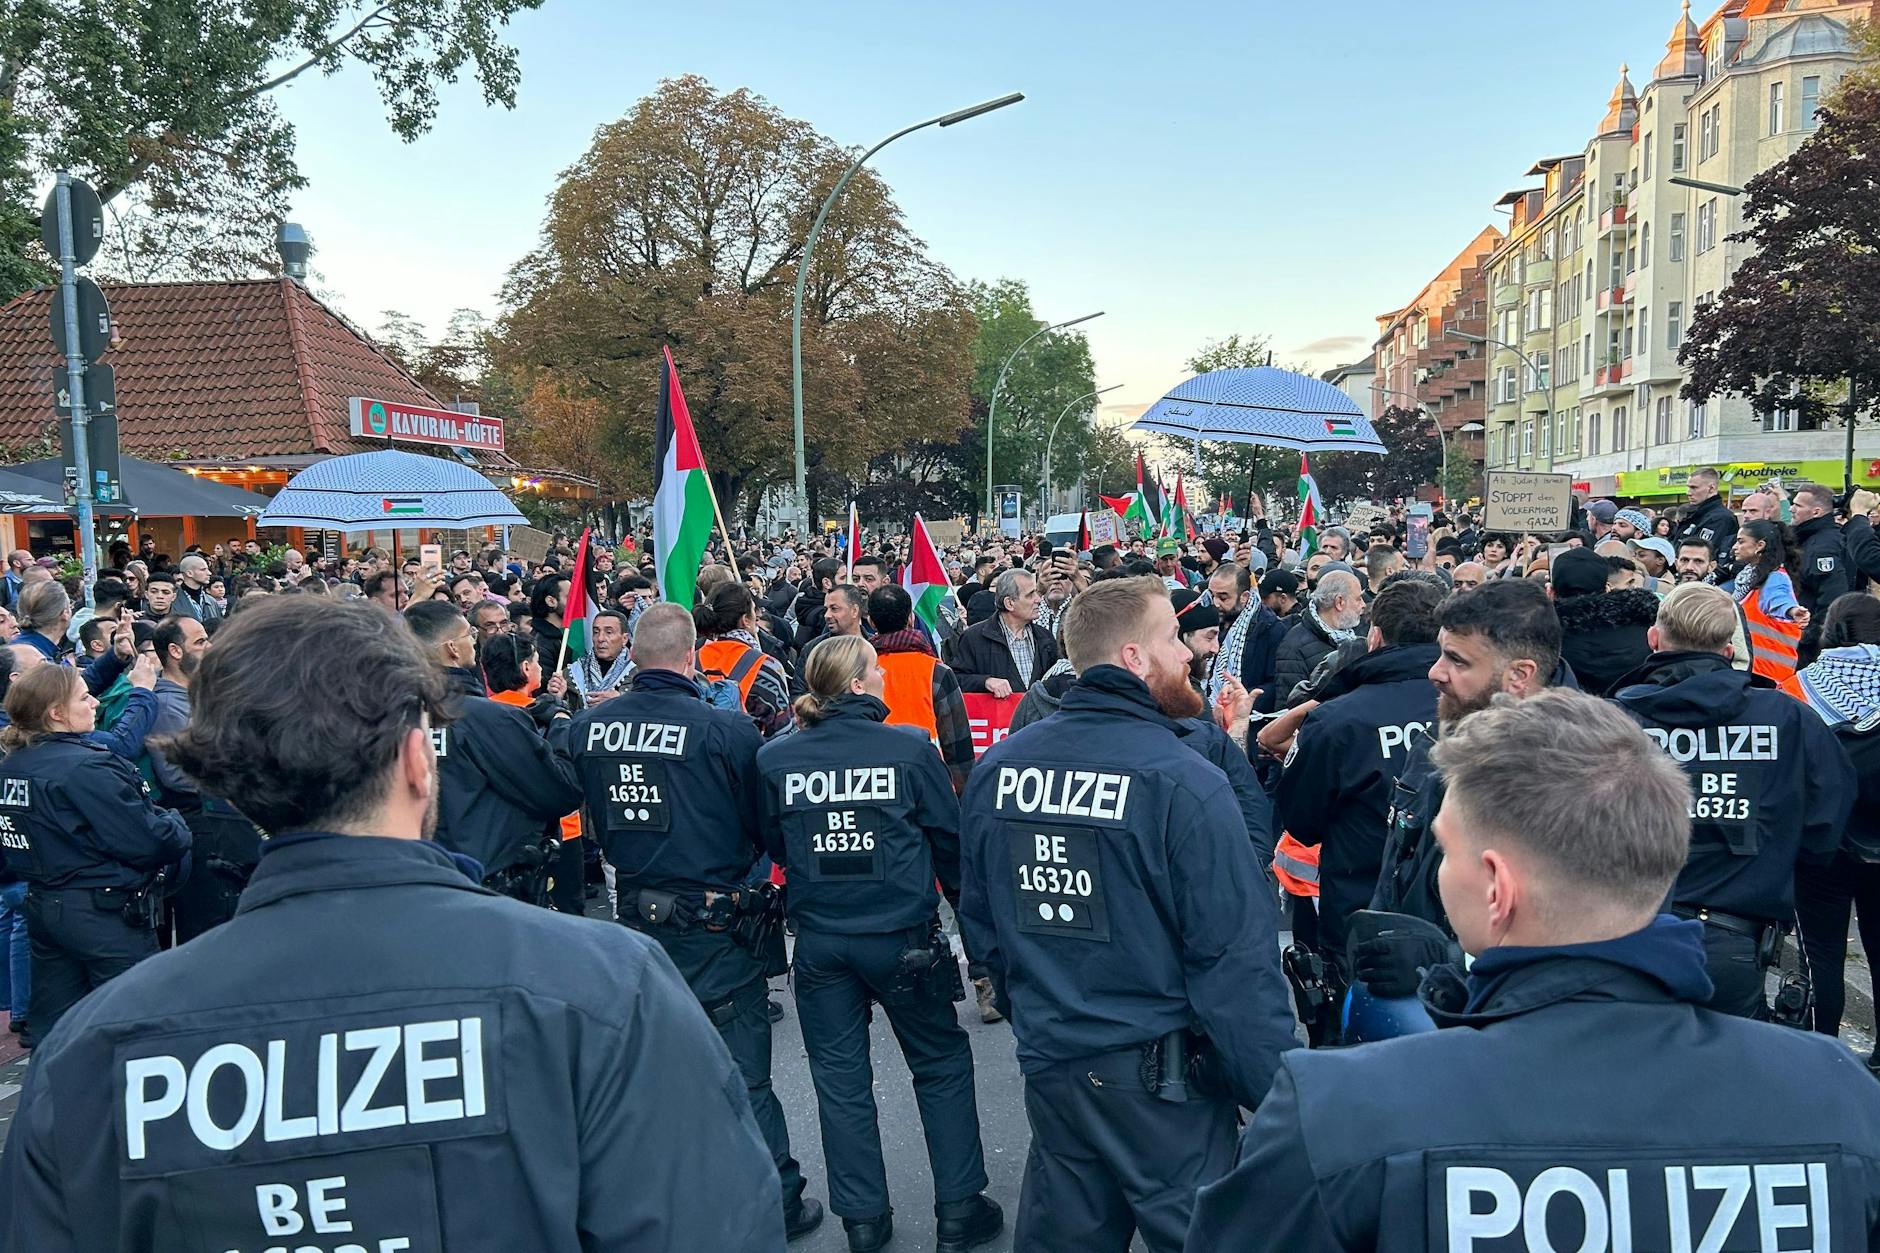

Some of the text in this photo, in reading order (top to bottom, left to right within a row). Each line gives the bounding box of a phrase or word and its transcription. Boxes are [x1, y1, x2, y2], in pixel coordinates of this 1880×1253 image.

[391, 411, 501, 445] KAVURMA-KÖFTE
[1736, 465, 1797, 479] Apotheke
[1491, 490, 1533, 503] STOPPT
[1353, 506, 1374, 518] STOP
[1526, 516, 1559, 529] GAZA!
[586, 721, 687, 756] POLIZEI
[619, 764, 644, 782] BE
[608, 784, 662, 803] 16321
[785, 767, 896, 806] POLIZEI
[996, 767, 1131, 821] POLIZEI
[1701, 773, 1737, 795] BE
[0, 815, 15, 831] BE
[827, 810, 856, 830] BE
[812, 831, 875, 852] 16326
[1034, 833, 1068, 864] BE
[1018, 864, 1093, 897] 16320
[125, 1017, 486, 1160] POLIZEI
[255, 1175, 353, 1237] BE
